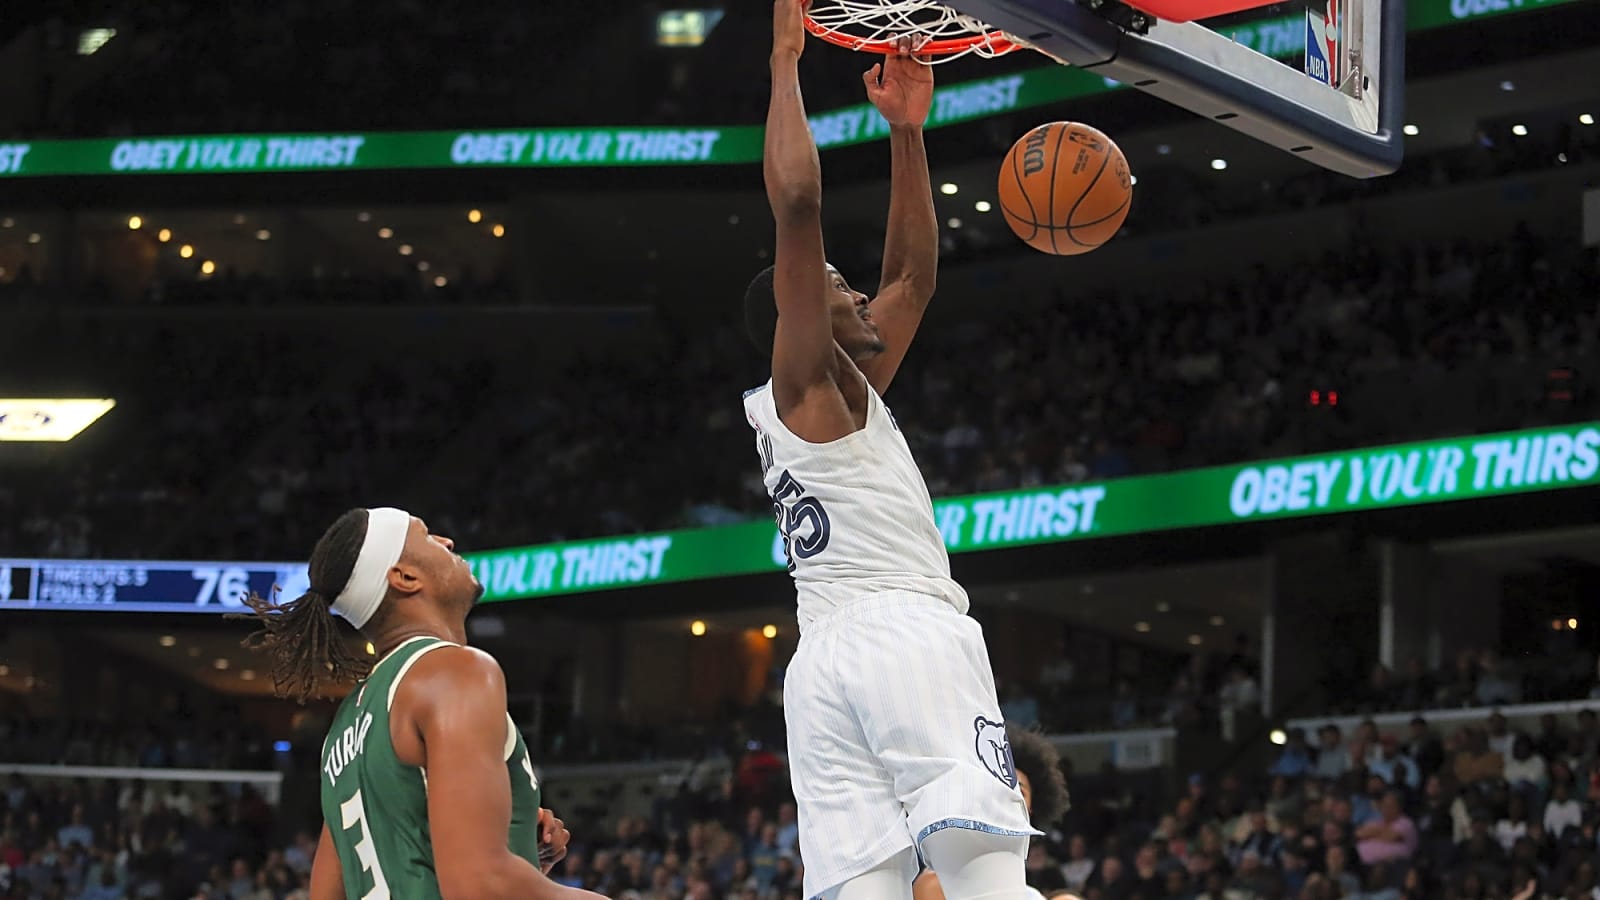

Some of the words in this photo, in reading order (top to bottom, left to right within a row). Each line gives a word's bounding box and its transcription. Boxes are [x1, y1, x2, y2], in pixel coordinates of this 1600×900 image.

[1309, 55, 1325, 80] NBA
[934, 76, 1025, 123] THIRST
[451, 132, 530, 164] OBEY
[532, 131, 613, 162] YOUR
[614, 130, 720, 161] THIRST
[808, 108, 865, 146] BEY
[110, 140, 184, 170] OBEY
[185, 138, 262, 169] YOUR
[264, 136, 365, 167] THIRST
[1229, 459, 1344, 517] OBEY
[1346, 446, 1465, 505] YOUR
[1471, 428, 1600, 490] THIRS
[972, 485, 1106, 545] THIRST
[561, 536, 672, 588] THIRST
[192, 566, 250, 608] 76
[323, 711, 373, 788] TURR
[340, 788, 391, 900] 3
